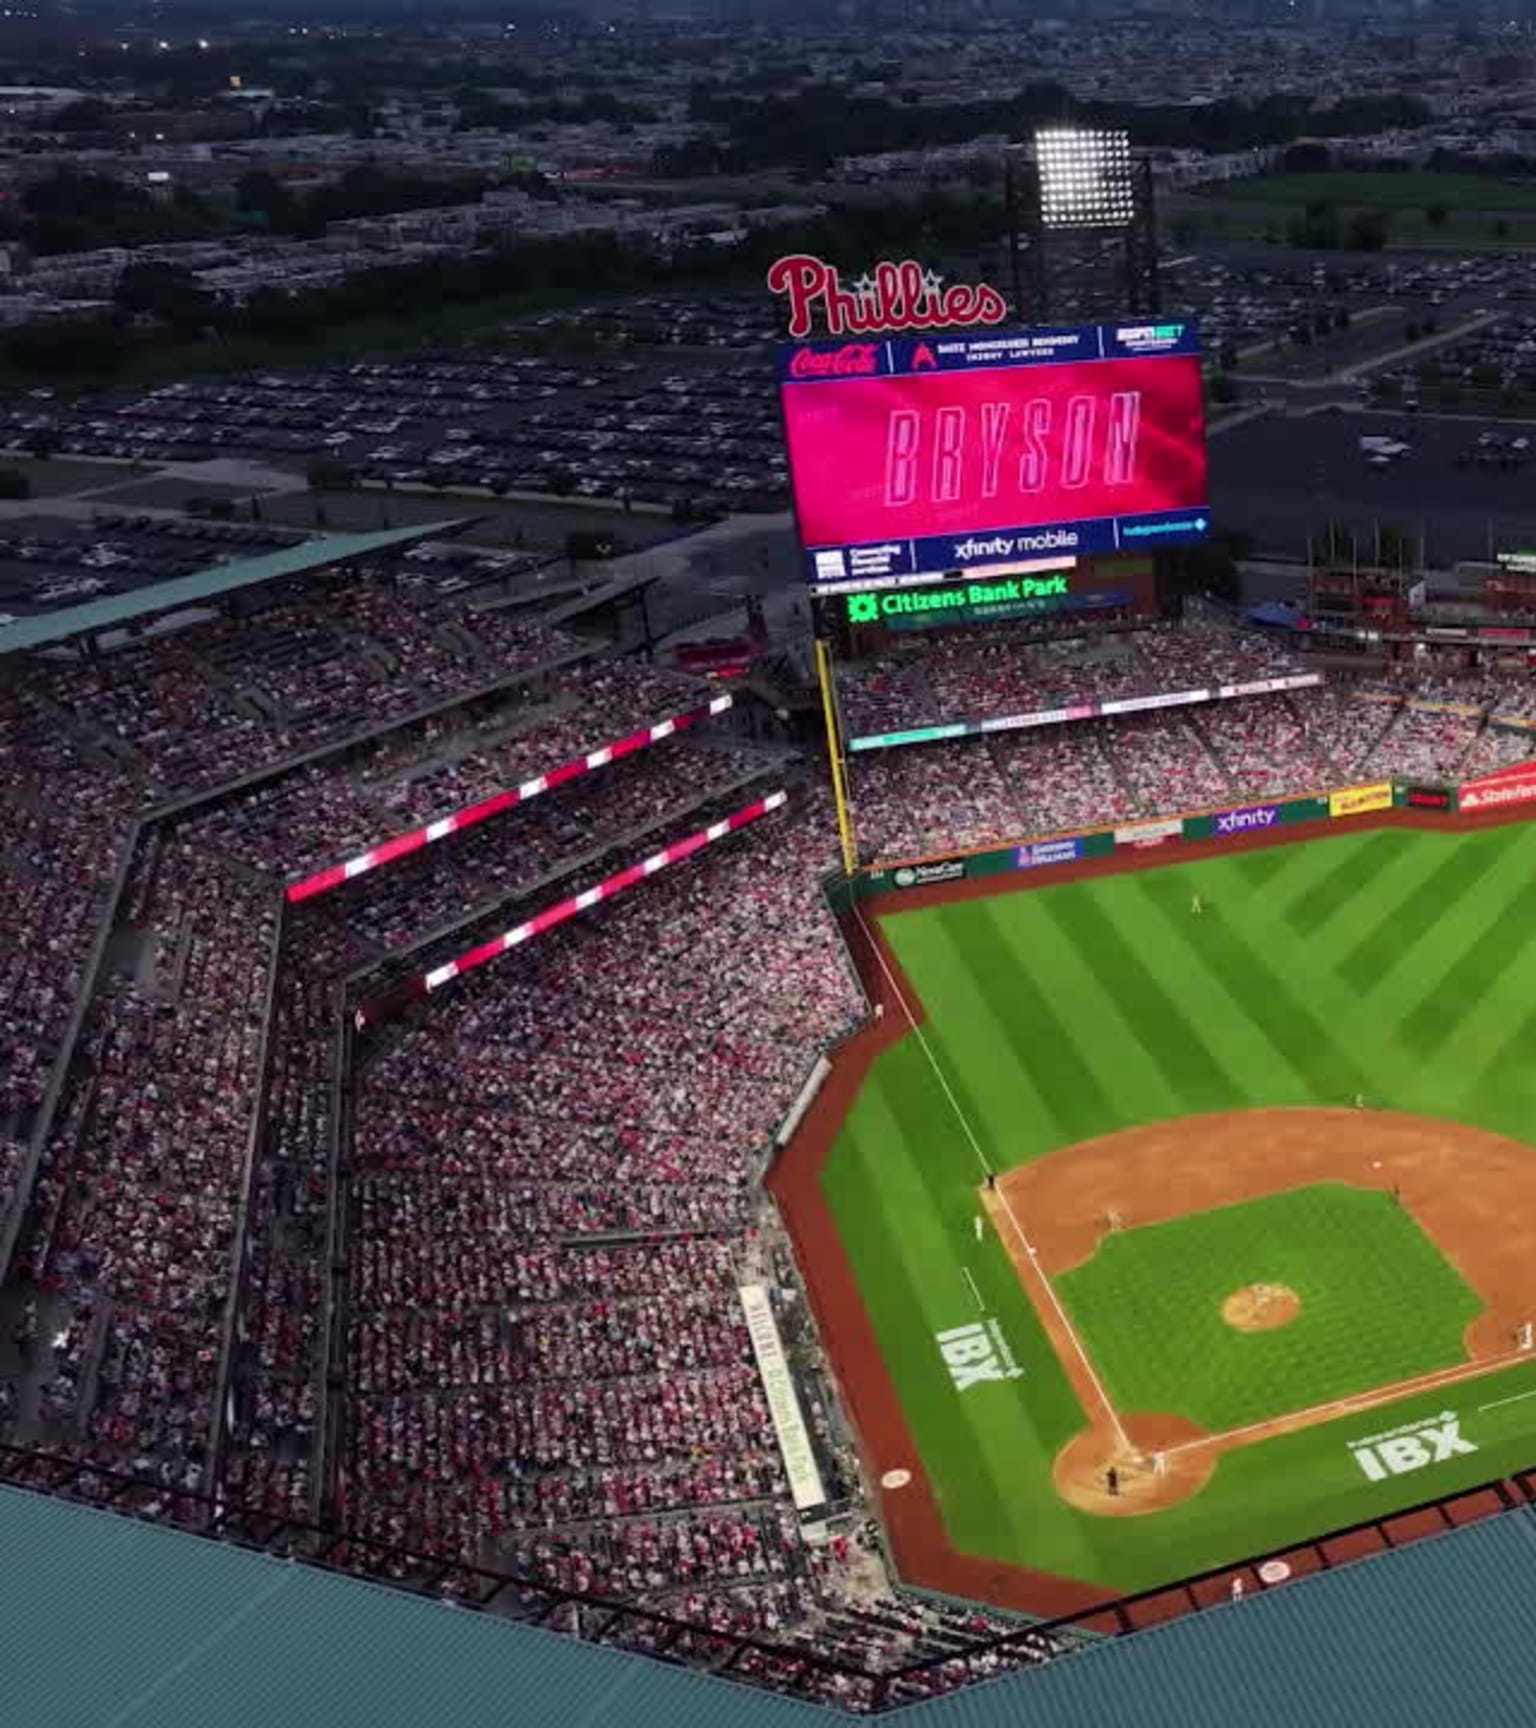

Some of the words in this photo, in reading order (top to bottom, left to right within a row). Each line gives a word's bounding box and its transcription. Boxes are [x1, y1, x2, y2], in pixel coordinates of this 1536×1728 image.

[768, 255, 1006, 336] Phillies
[884, 391, 1141, 508] BRYSON
[954, 537, 1015, 560] xfinity
[1017, 530, 1079, 551] mobile
[882, 590, 966, 614] Citizens
[968, 581, 1021, 604] Bank
[1021, 575, 1068, 597] Park
[1216, 807, 1276, 832] xfinity
[936, 1322, 1004, 1392] IBX
[1354, 1420, 1479, 1482] IBX
